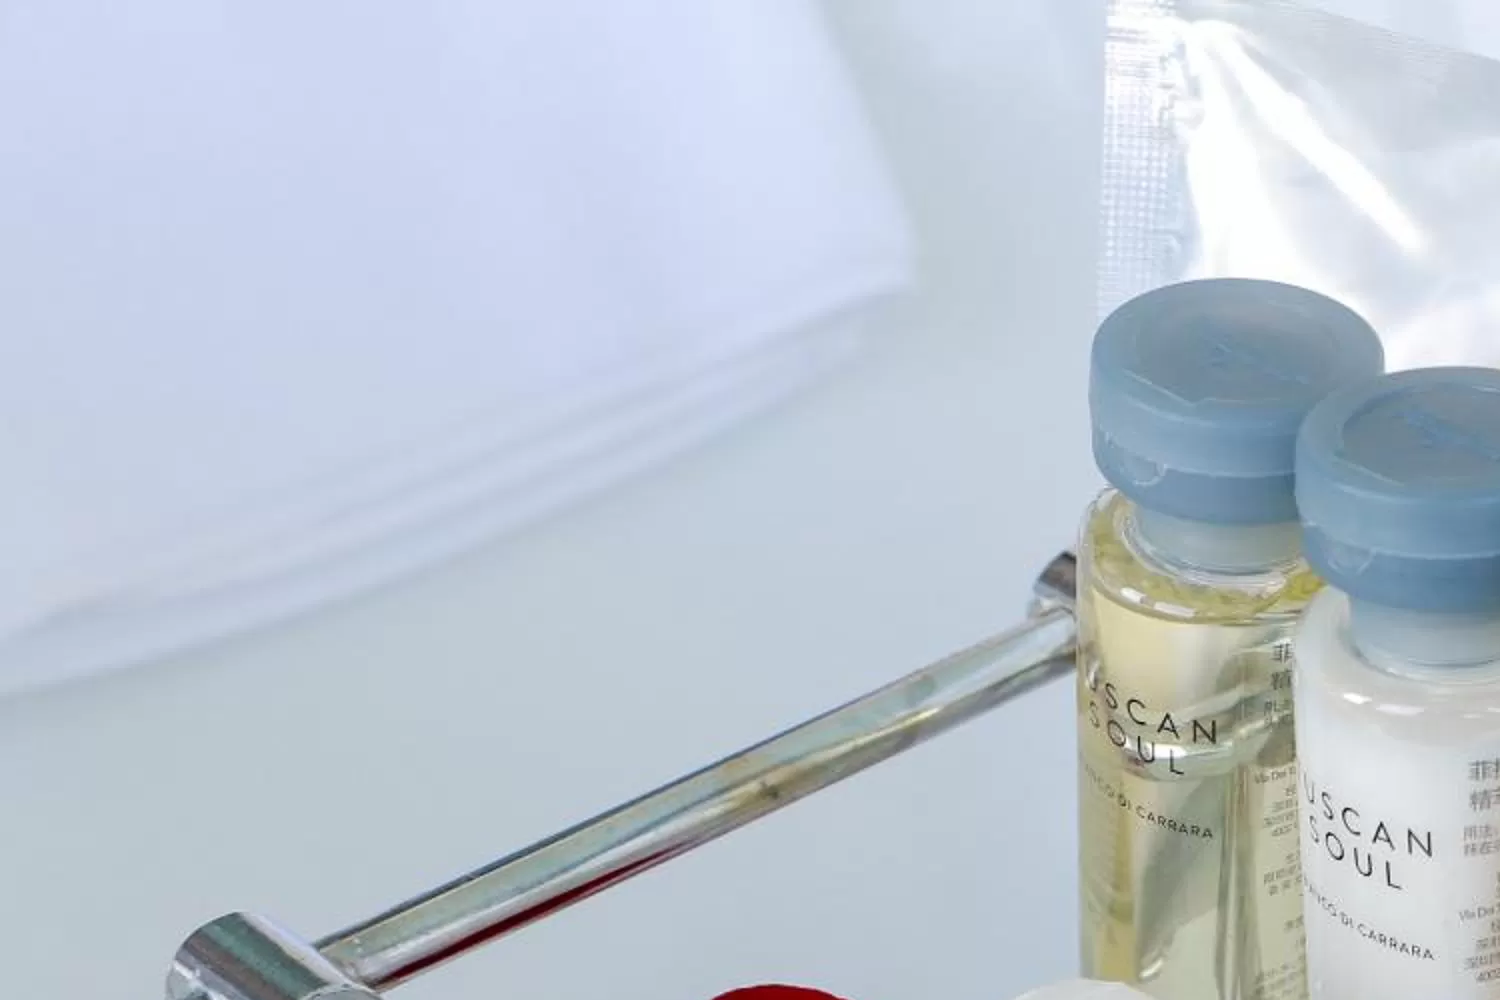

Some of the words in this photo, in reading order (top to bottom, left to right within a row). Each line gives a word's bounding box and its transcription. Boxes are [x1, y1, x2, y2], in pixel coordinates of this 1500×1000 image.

[1089, 700, 1185, 775] SOUL
[1135, 804, 1214, 840] CARRARA
[1309, 814, 1403, 890] SOUL
[1356, 922, 1436, 961] CARRARA
